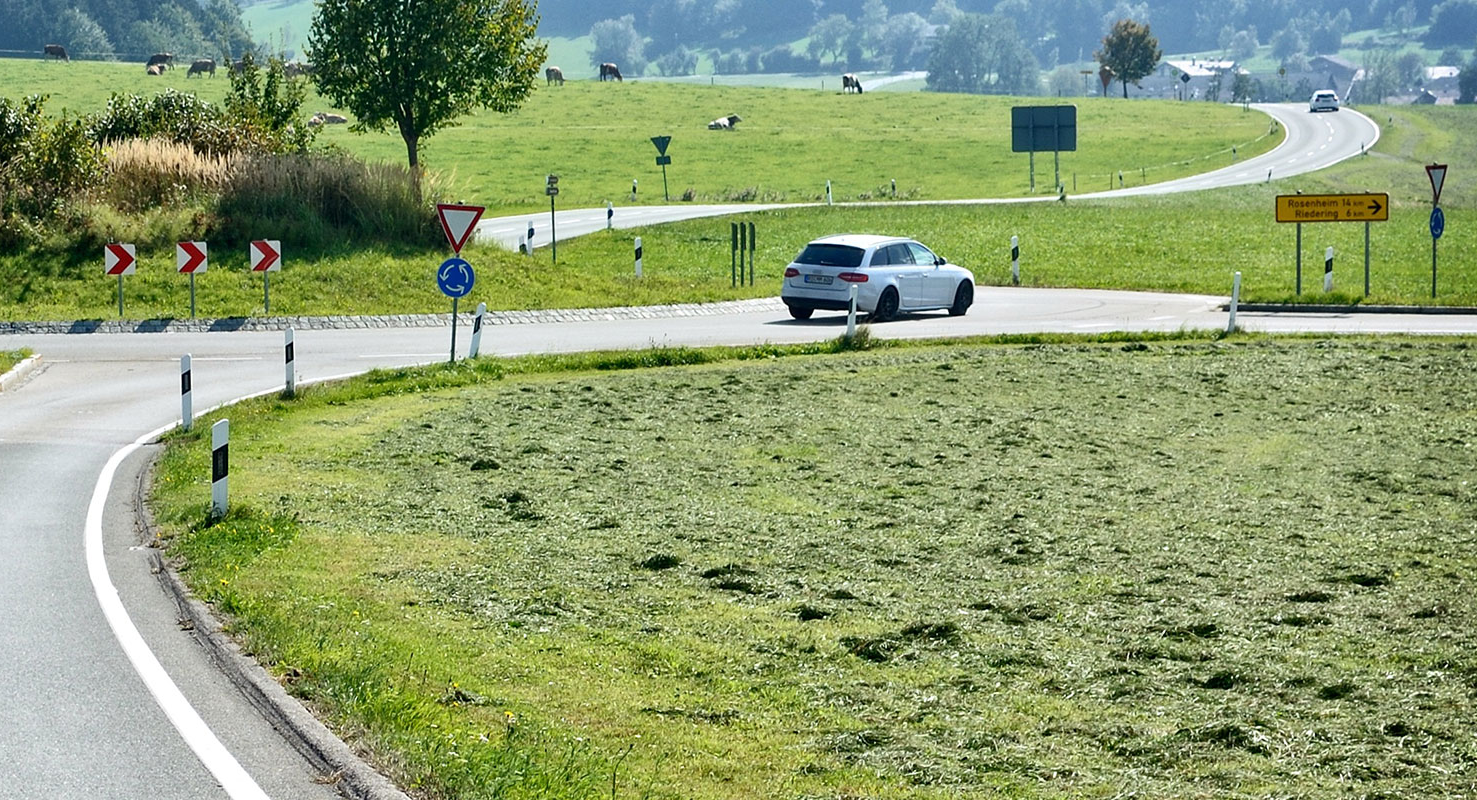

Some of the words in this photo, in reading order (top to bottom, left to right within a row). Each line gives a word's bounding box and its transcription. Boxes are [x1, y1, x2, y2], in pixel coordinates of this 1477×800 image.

[1288, 199, 1339, 208] Rosenheim
[1342, 198, 1351, 207] 14
[1295, 210, 1339, 220] Riedering
